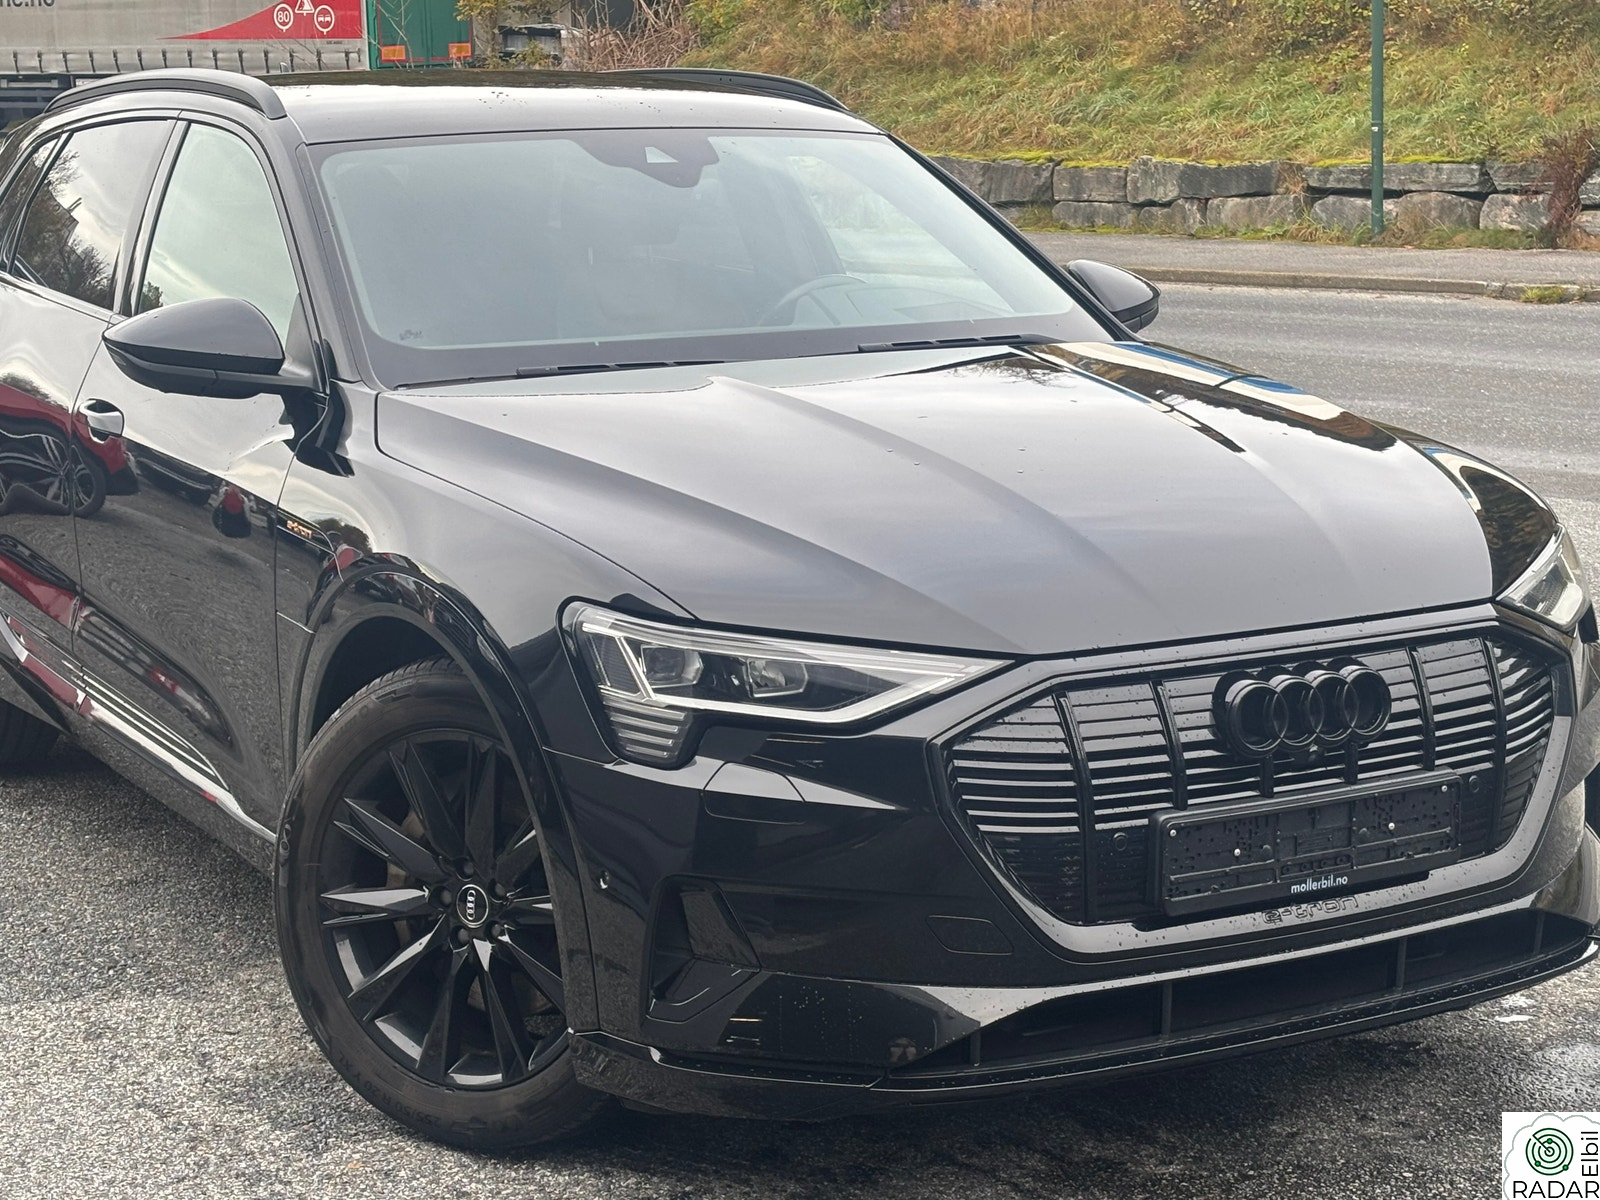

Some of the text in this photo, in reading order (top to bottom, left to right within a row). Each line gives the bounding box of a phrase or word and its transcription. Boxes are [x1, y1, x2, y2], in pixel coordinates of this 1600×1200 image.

[277, 11, 290, 23] 80
[1291, 873, 1348, 894] mollerbil.no
[1262, 895, 1359, 925] e-tron
[364, 1080, 380, 1097] 20
